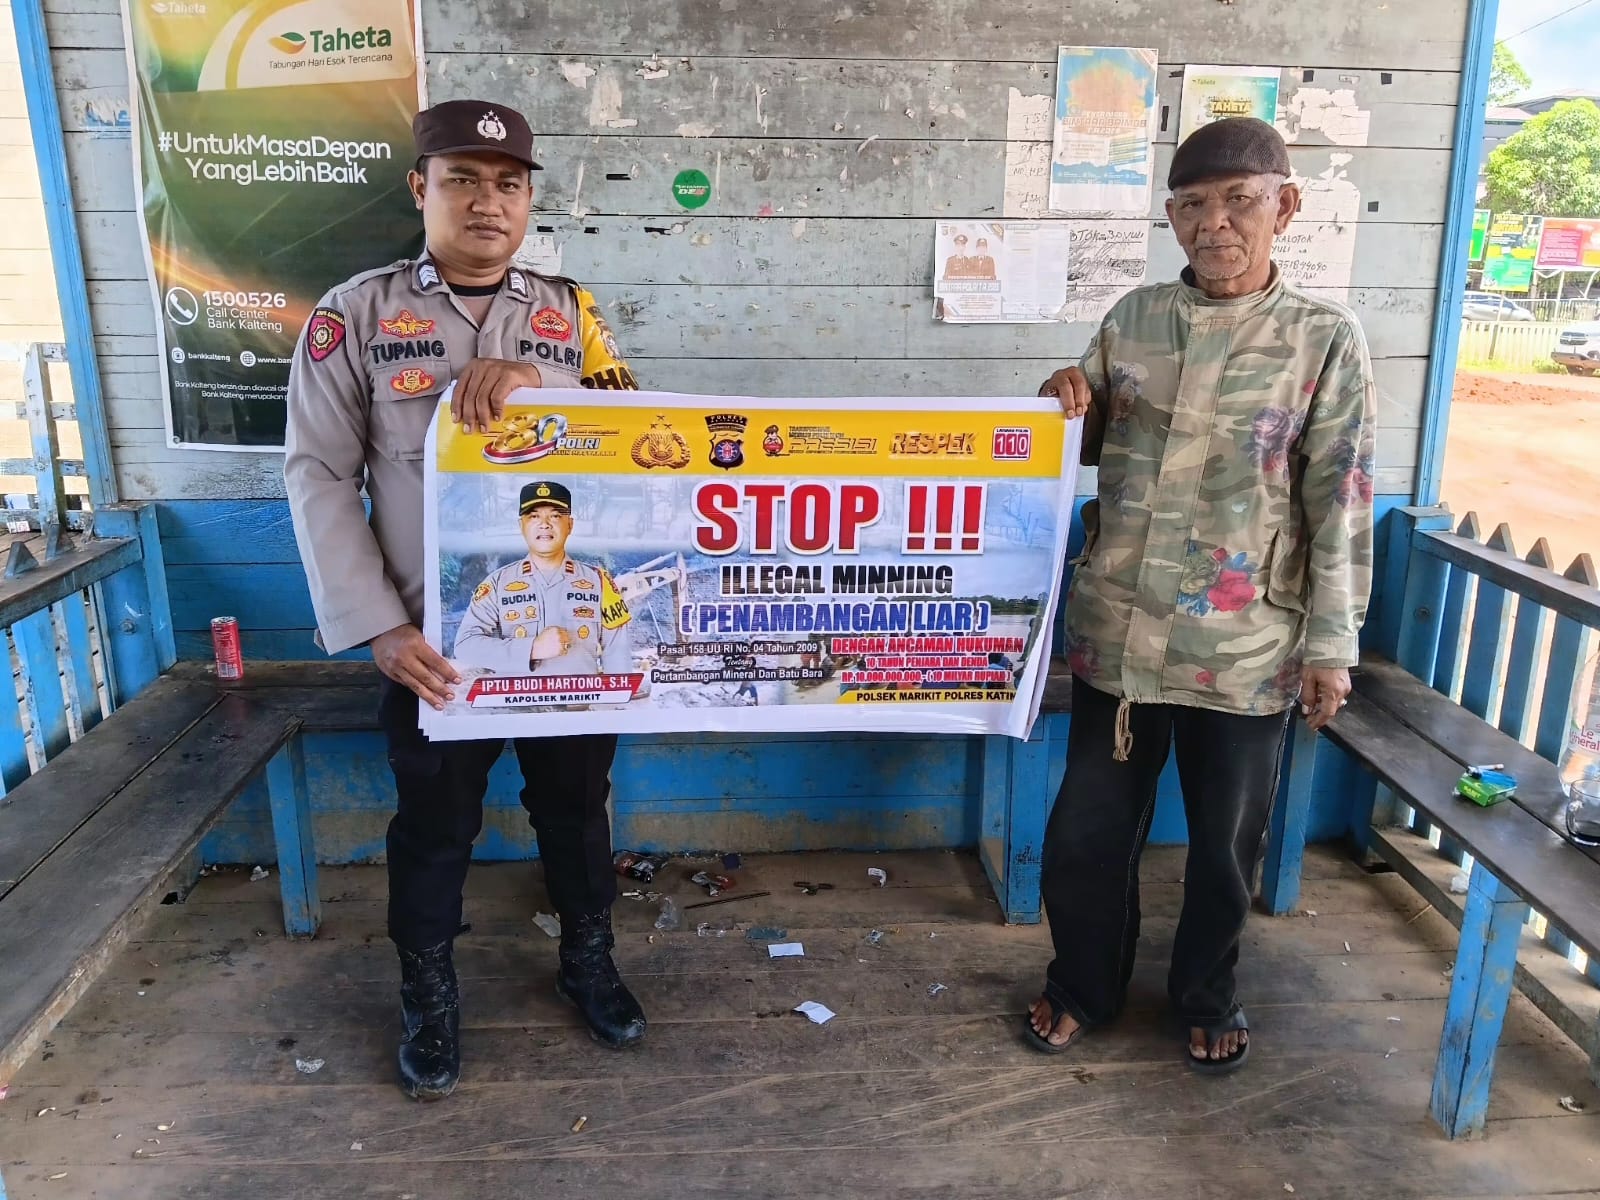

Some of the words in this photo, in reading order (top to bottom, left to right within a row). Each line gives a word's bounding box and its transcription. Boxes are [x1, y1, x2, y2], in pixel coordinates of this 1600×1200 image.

[309, 26, 392, 53] Taheta
[269, 59, 306, 69] Tabungan
[308, 58, 325, 67] Hari
[326, 56, 346, 66] Esok
[348, 53, 393, 64] Terencana
[158, 131, 391, 163] #UntukMasaDepan
[185, 157, 368, 186] YangLebihBaik
[203, 290, 287, 308] 1500526
[206, 307, 227, 318] Call
[230, 308, 269, 319] Center
[208, 318, 236, 329] Bank
[239, 319, 282, 333] Kalteng
[188, 352, 231, 363] bankkalteng
[370, 340, 446, 364] TUPANG
[519, 340, 582, 369] POLRI
[555, 438, 601, 450] POLRI
[891, 432, 977, 454] RESPEK
[995, 434, 1029, 454] 110
[694, 482, 882, 553] STOP
[905, 483, 984, 552] !!!
[721, 565, 826, 595] ILLEGAL
[832, 564, 953, 594] MINNING
[501, 594, 537, 606] BUDI.H
[566, 592, 600, 603] POLRI
[698, 603, 908, 633] PENAMBANGAN
[912, 602, 973, 632] LIAR
[660, 645, 685, 654] Pasal
[707, 644, 720, 653] UU
[724, 644, 733, 653] RI
[736, 644, 750, 653] No.
[753, 643, 764, 653] 04
[767, 643, 794, 653] Tahun
[796, 642, 818, 652] 2009
[832, 638, 886, 654] DENGAN
[888, 638, 954, 654] ANCAMAN
[956, 637, 1024, 653] HUKUMAN
[725, 655, 753, 667] Tentang
[866, 658, 875, 668] 10
[877, 657, 905, 668] TAHUN
[942, 657, 960, 668] DAN
[960, 656, 988, 667] DENDA
[653, 671, 720, 683] Pertambangan
[723, 670, 756, 680] Mineral
[759, 669, 776, 679] Dan
[779, 669, 799, 679] Batu
[802, 668, 823, 678] Bara
[482, 679, 509, 692] IPTU
[514, 678, 543, 691] BUDI
[547, 677, 606, 690] HARTONO,
[609, 676, 632, 689] S.H.
[504, 694, 557, 704] KAPOLSEK
[559, 693, 601, 702] MARIKIT
[857, 692, 896, 702] POLSEK
[899, 691, 942, 701] MARIKIT
[944, 691, 983, 701] POLRES
[1581, 725, 1594, 740] Le
